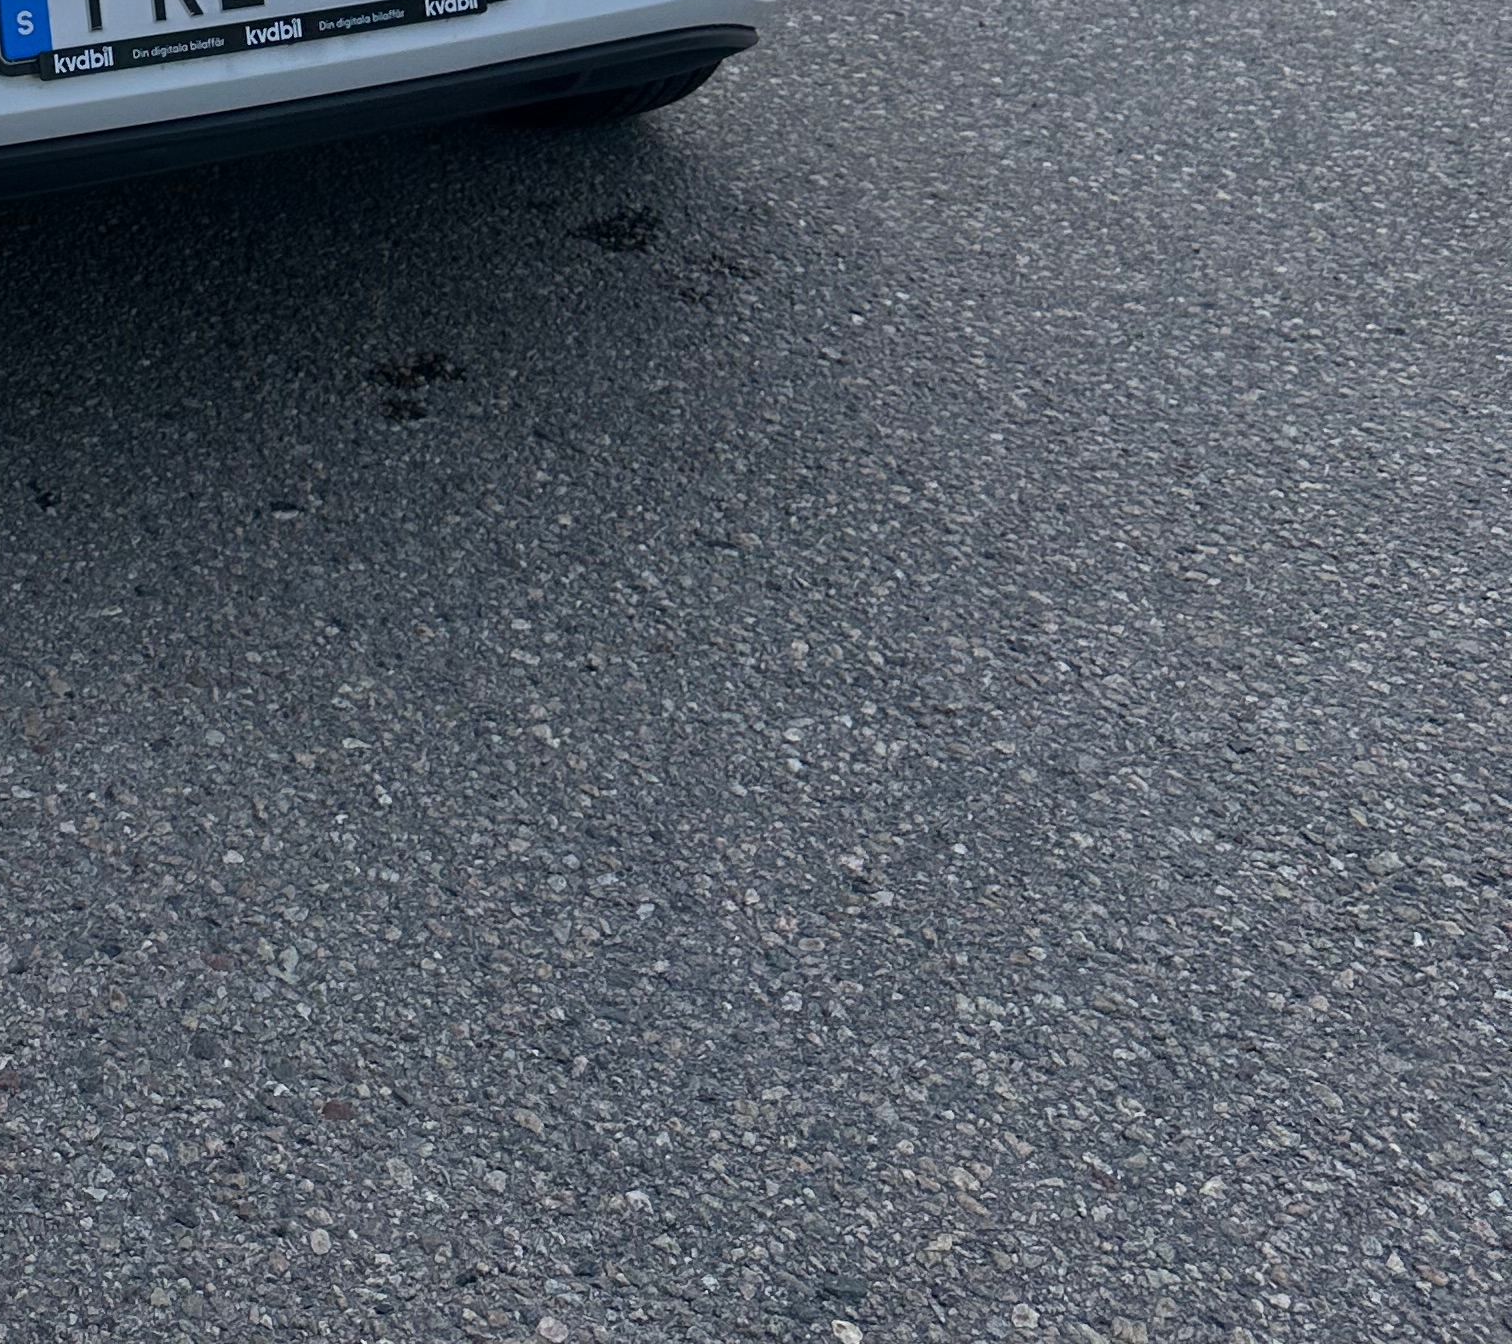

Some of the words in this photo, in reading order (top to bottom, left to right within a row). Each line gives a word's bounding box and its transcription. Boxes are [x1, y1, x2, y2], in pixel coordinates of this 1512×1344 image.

[16, 10, 34, 35] S
[54, 46, 114, 74] kvdbil
[132, 48, 150, 60] Din
[151, 43, 189, 59] digitala
[245, 18, 303, 45] kvdbil
[319, 20, 335, 31] Din
[336, 15, 371, 29] digitala
